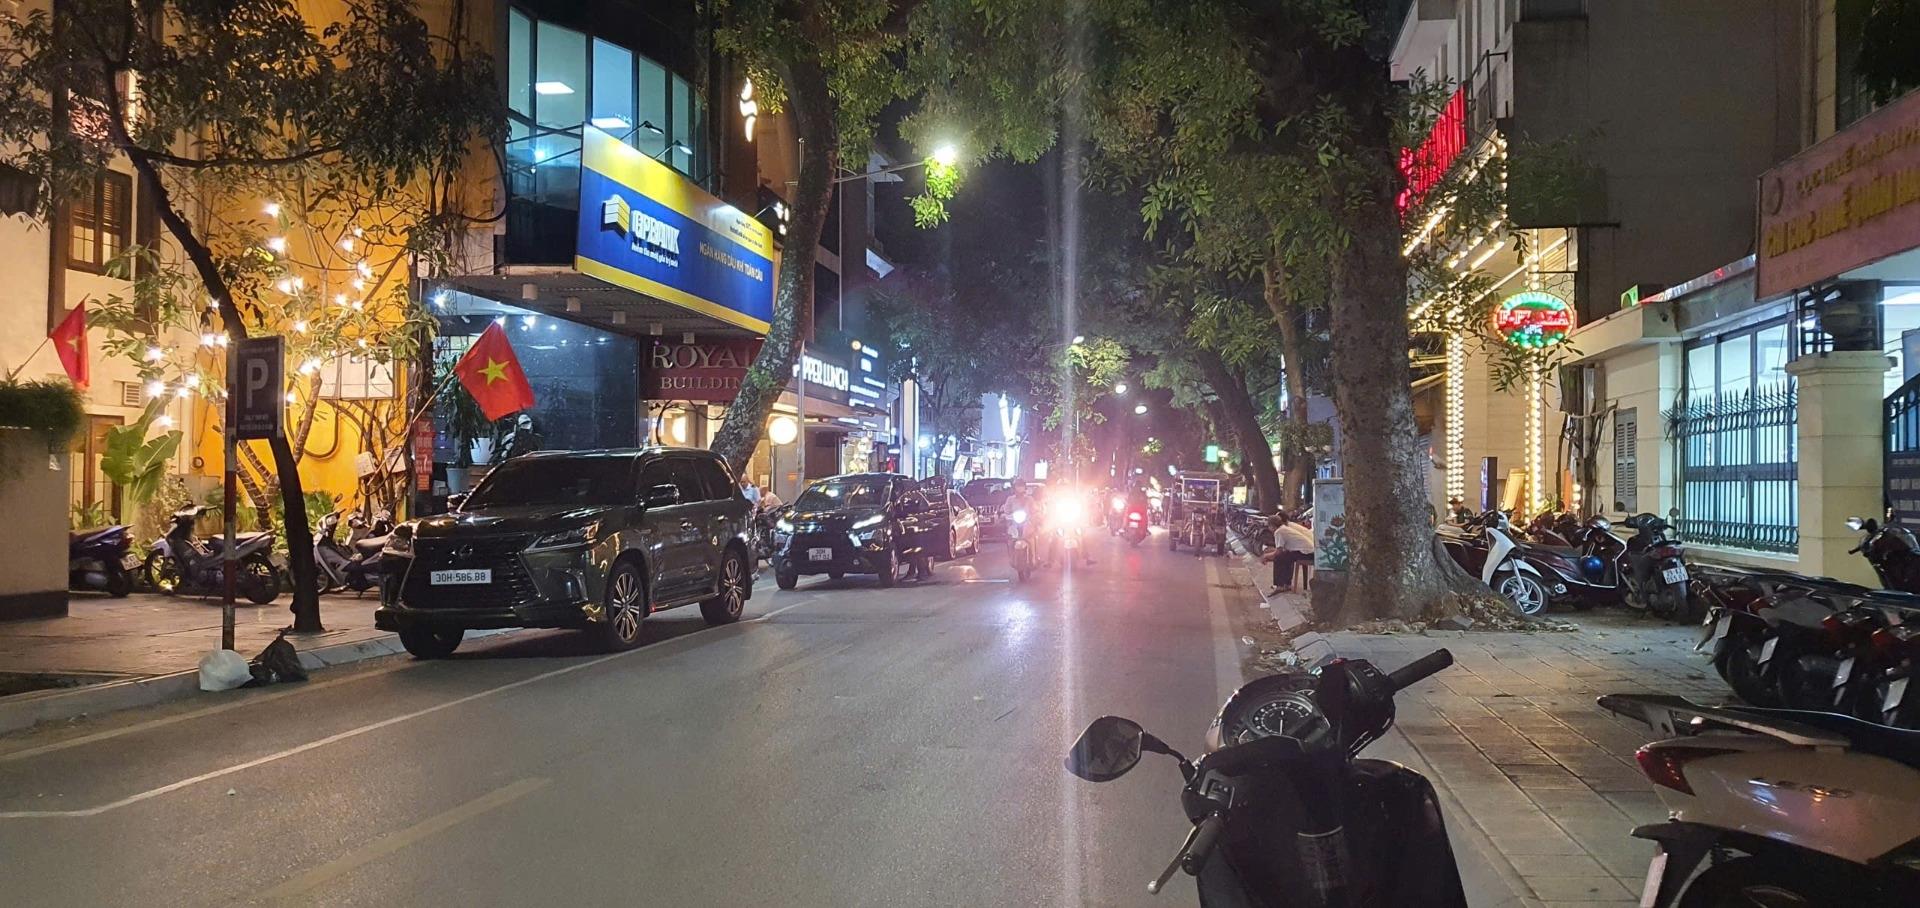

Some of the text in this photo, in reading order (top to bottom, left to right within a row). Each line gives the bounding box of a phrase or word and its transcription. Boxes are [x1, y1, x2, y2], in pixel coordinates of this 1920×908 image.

[246, 358, 269, 409] P
[823, 362, 849, 392] LUNCH
[435, 572, 486, 583] 30H-586.88
